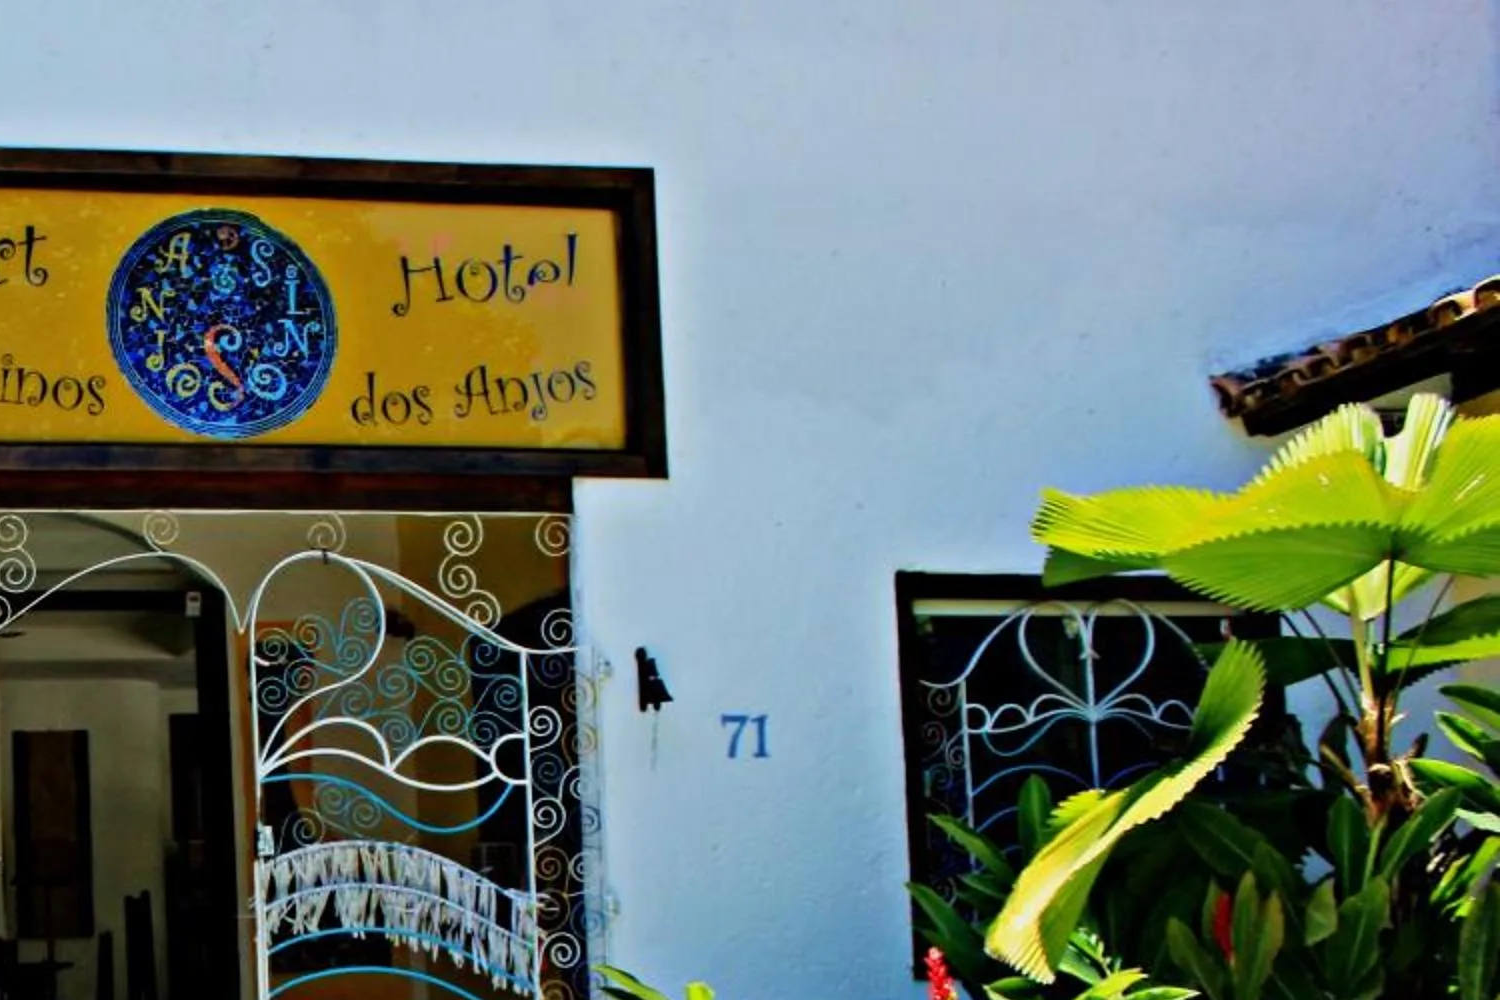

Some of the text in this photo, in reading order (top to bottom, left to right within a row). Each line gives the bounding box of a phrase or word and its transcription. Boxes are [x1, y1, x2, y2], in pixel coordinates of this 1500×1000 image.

[391, 232, 578, 317] Hotel
[351, 371, 434, 426] dos
[454, 360, 597, 421] Anjos
[721, 714, 770, 759] 71
